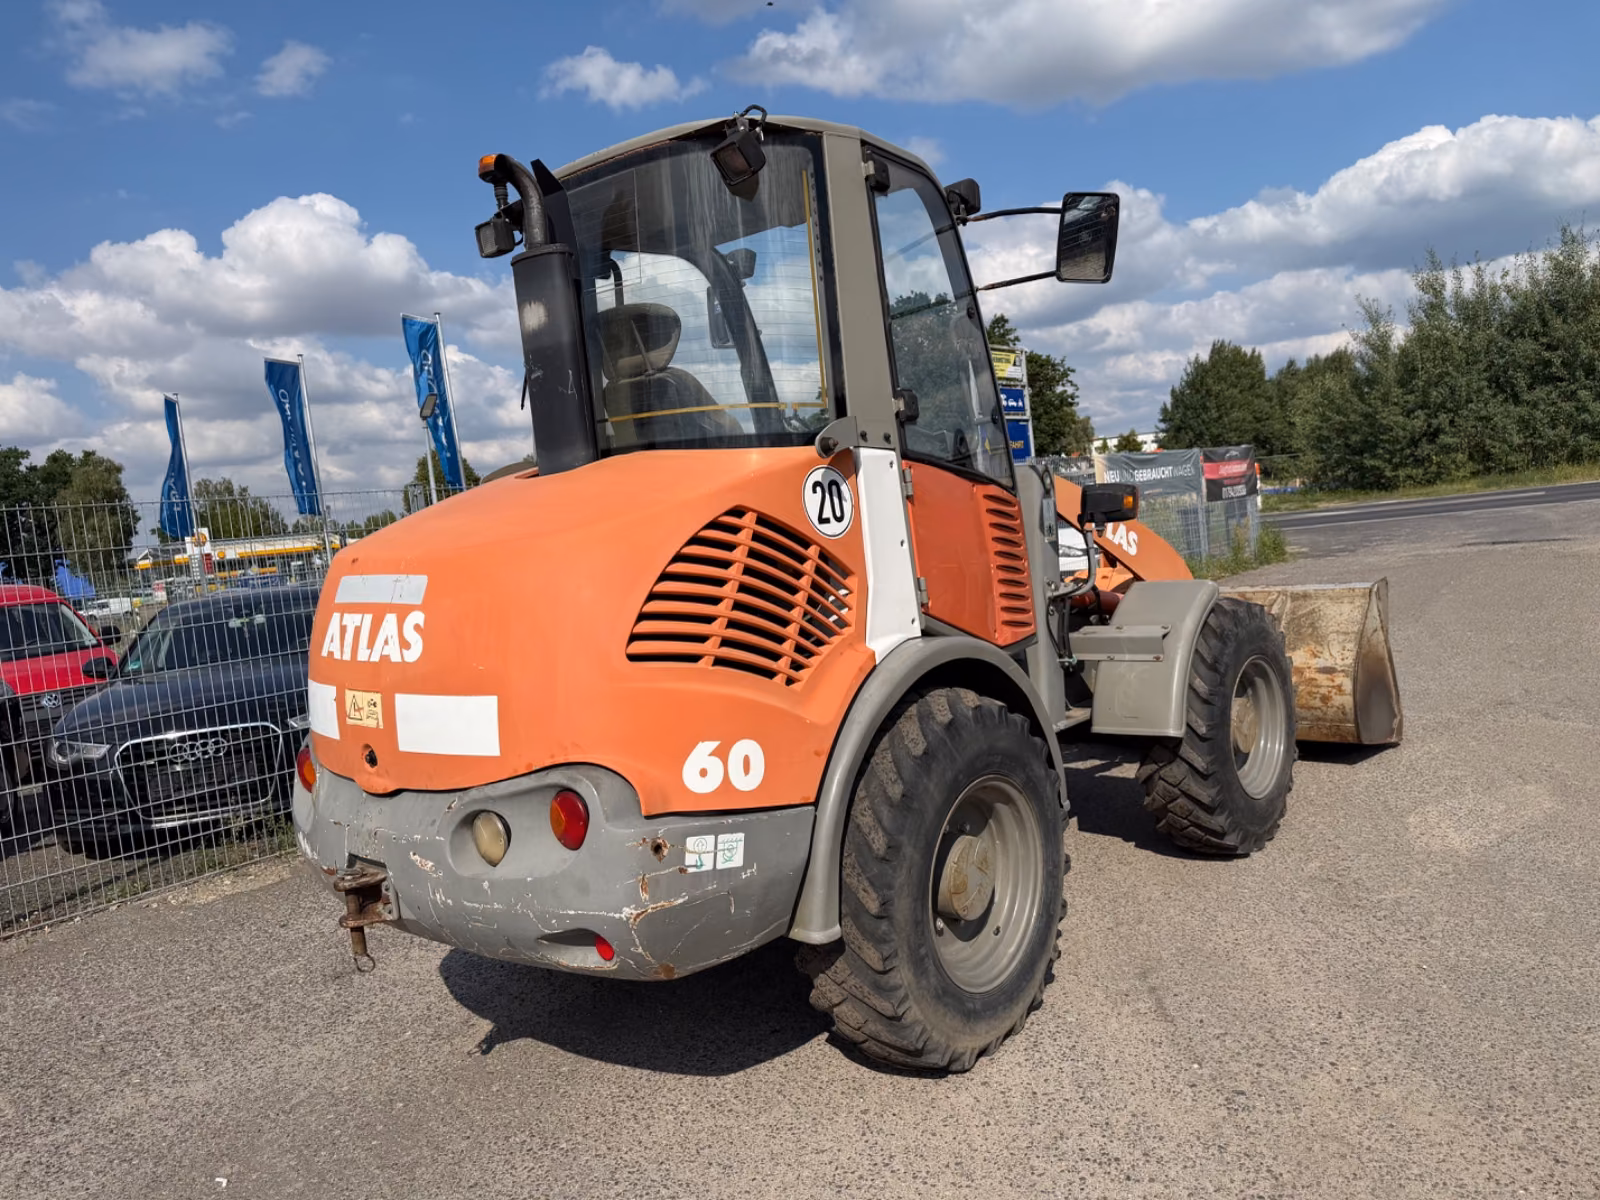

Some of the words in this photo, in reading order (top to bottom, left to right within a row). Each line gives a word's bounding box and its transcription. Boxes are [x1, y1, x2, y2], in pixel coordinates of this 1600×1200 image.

[1134, 466, 1173, 482] GEBRAUCHT
[812, 479, 845, 525] 20
[1105, 521, 1138, 556] LAS
[321, 610, 425, 663] ATLAS
[682, 738, 765, 794] 60
